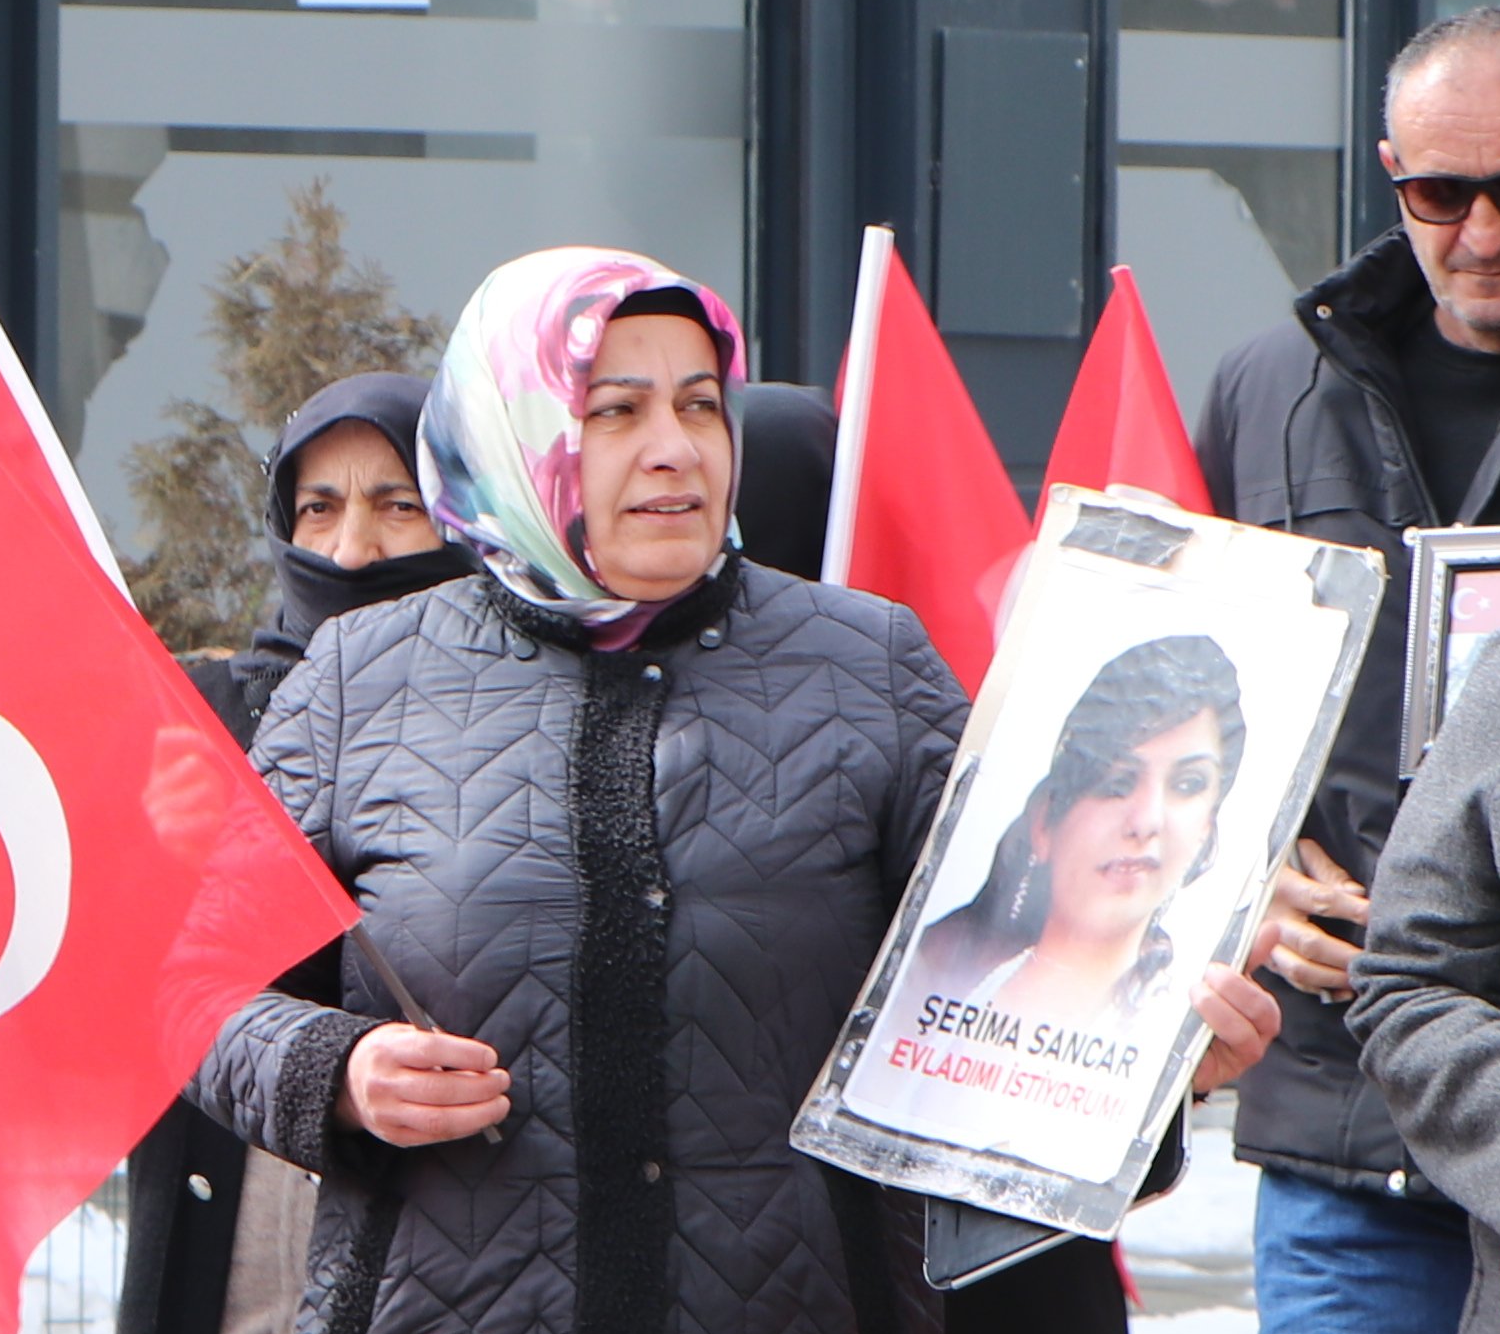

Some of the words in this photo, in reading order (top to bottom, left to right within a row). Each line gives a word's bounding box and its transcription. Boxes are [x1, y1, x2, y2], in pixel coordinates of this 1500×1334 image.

[889, 1037, 1001, 1092] EVLADIMI
[916, 993, 1021, 1052] ŞERİMA
[1028, 1023, 1139, 1079] SANCAR
